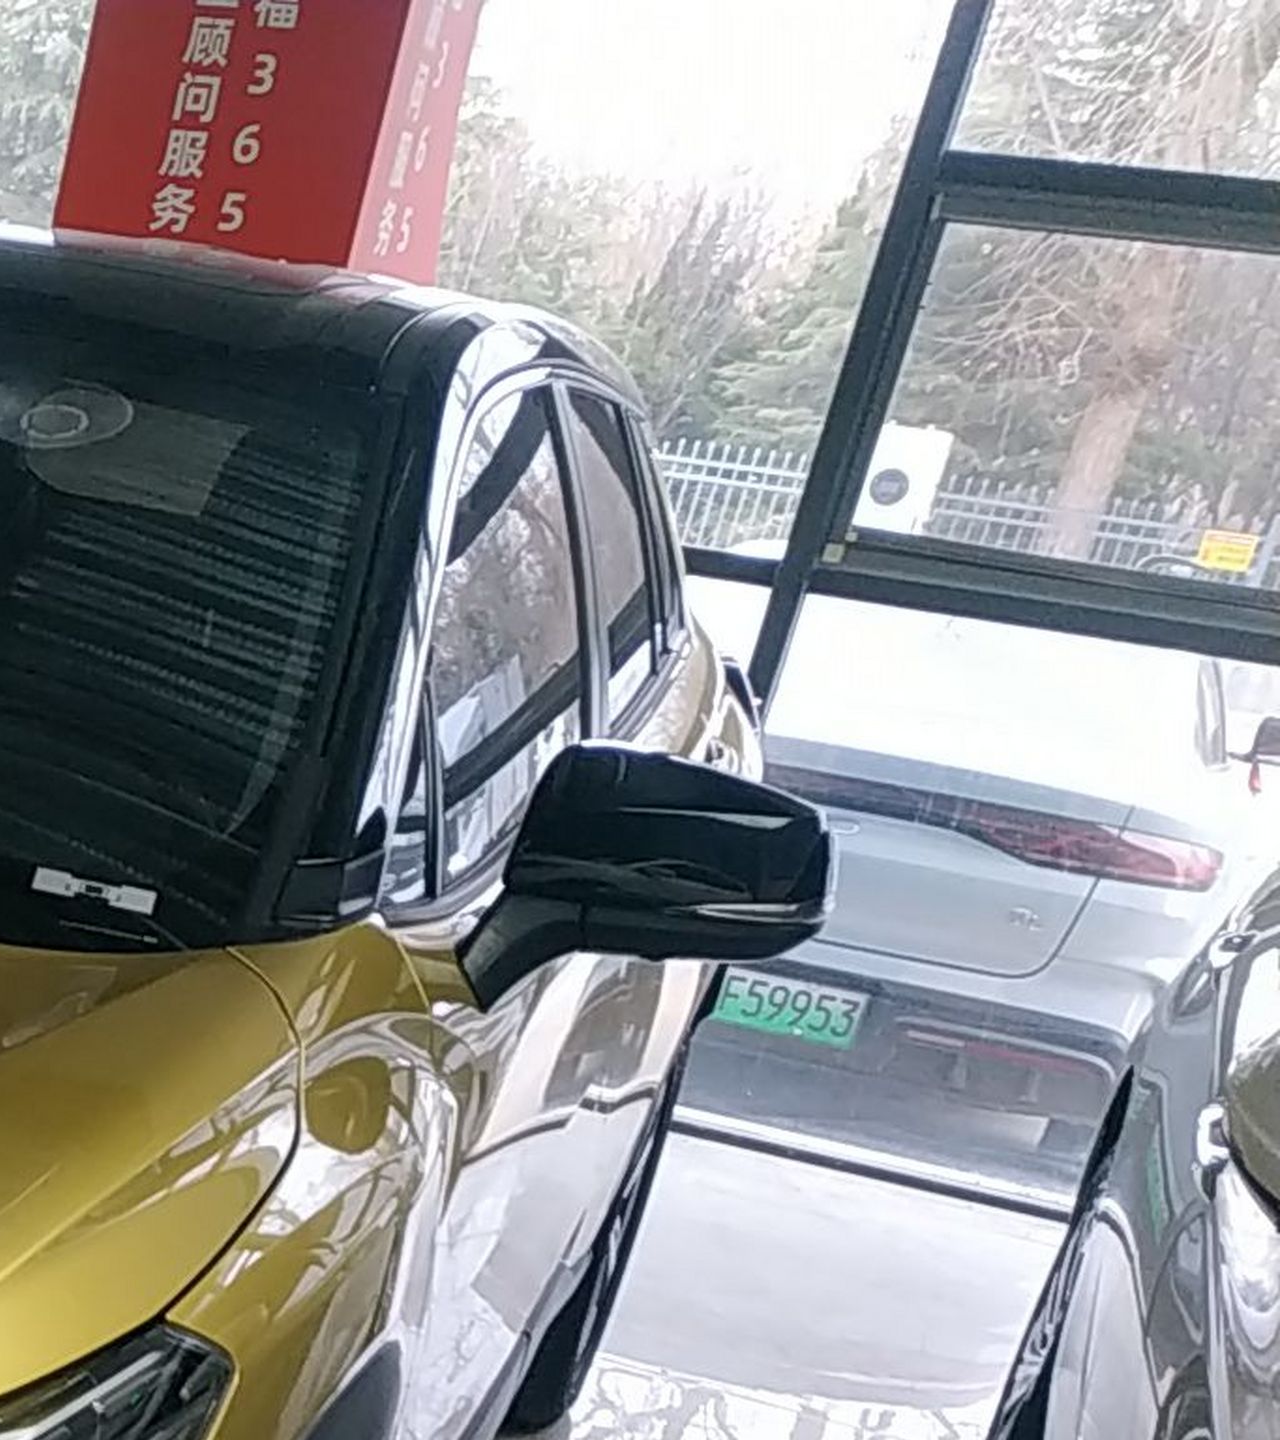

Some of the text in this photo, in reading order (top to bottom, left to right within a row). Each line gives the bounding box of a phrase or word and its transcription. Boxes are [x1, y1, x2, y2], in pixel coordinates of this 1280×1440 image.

[149, 0, 239, 233] 顾问服务
[719, 974, 861, 1037] F59953
